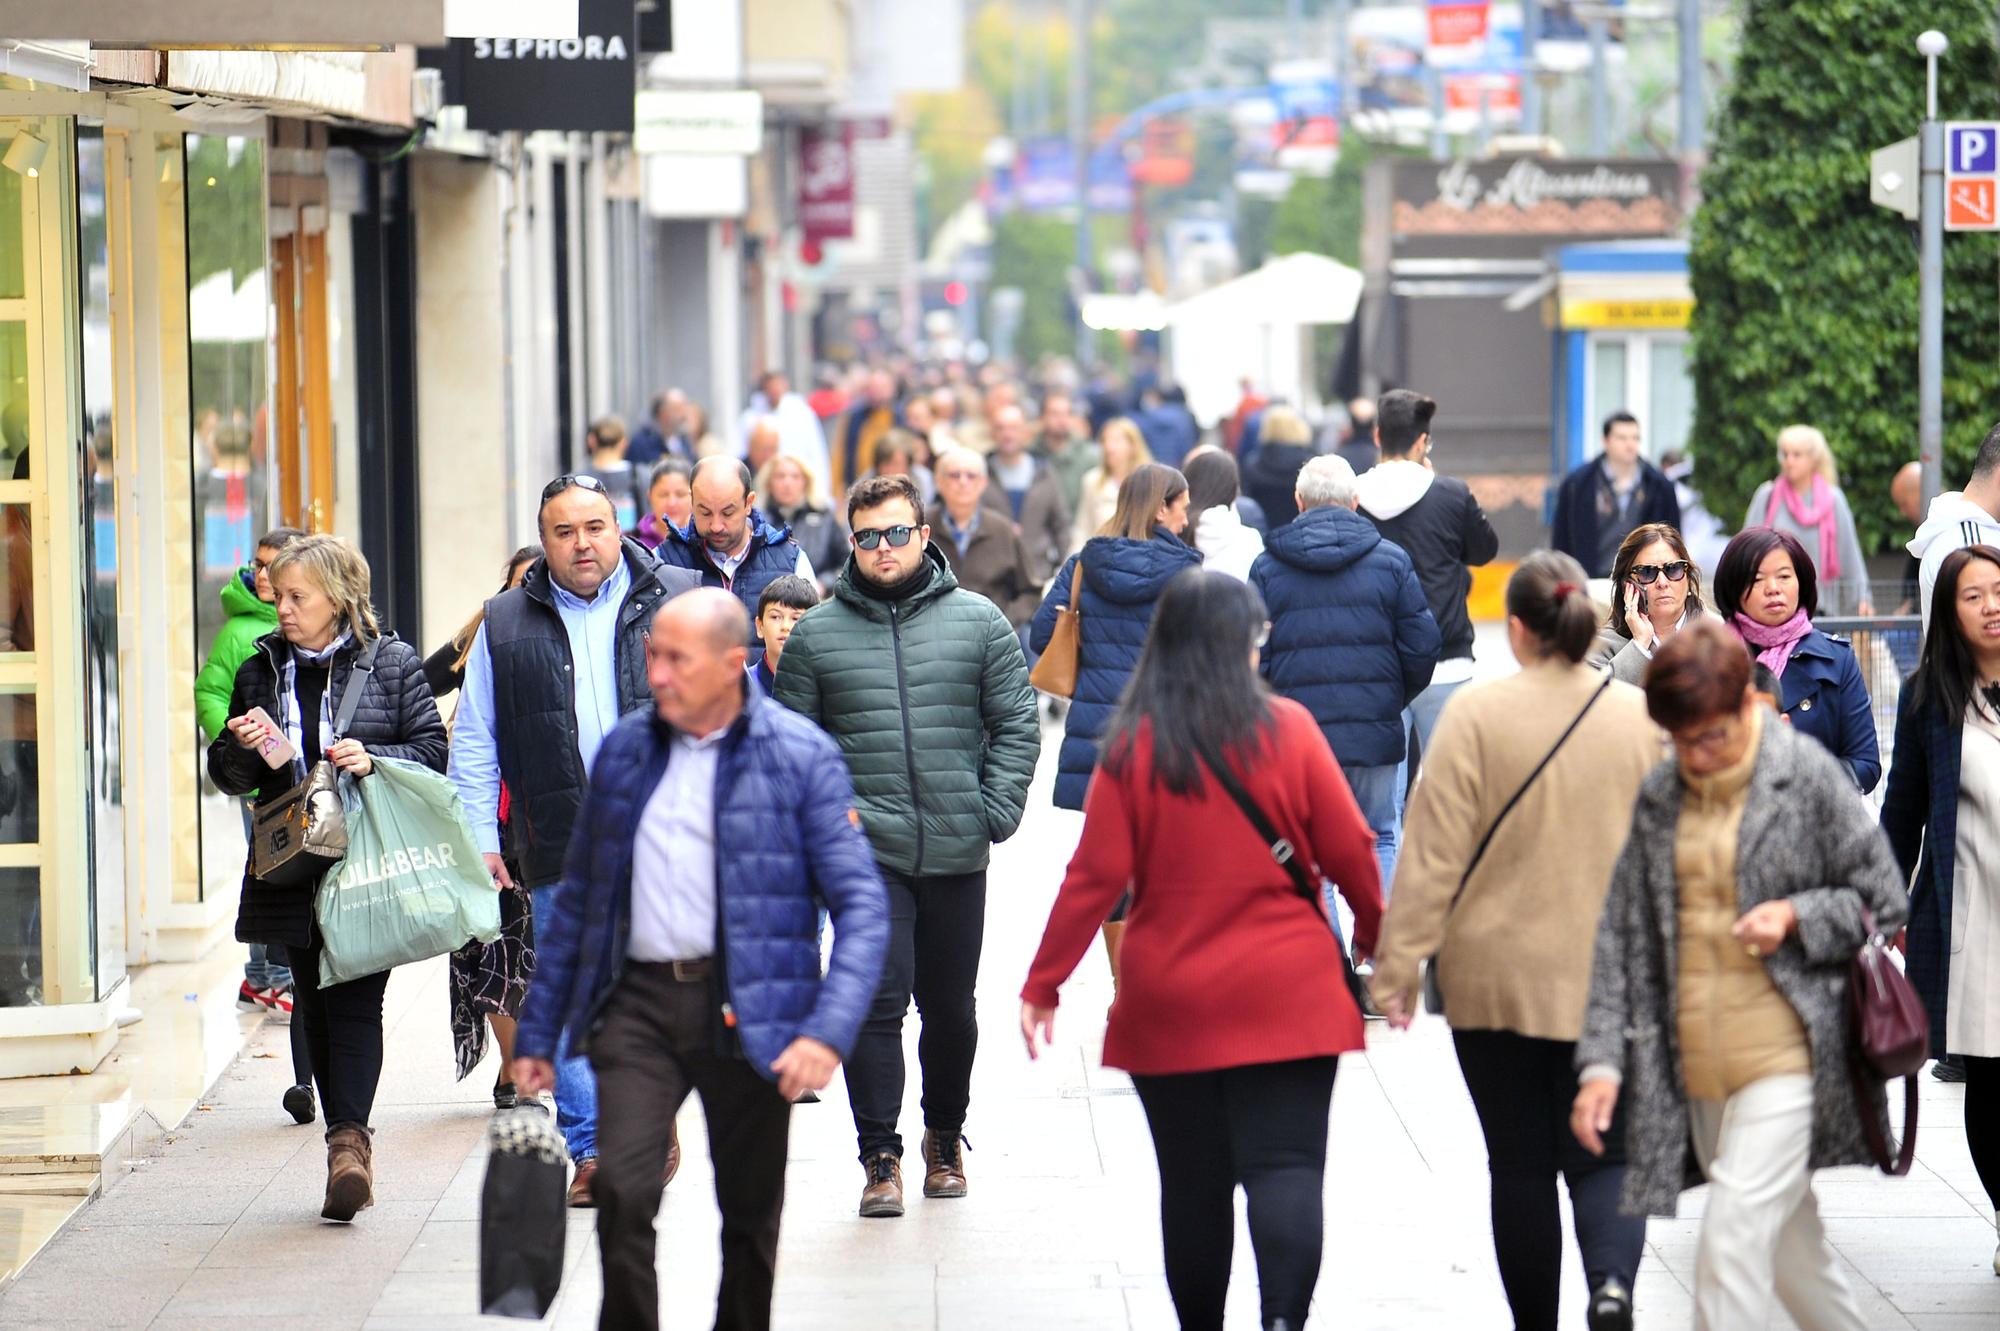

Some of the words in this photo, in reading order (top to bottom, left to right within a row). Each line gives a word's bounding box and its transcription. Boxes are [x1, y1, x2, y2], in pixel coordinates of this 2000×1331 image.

[474, 35, 628, 60] SEPHORA
[1960, 130, 1987, 171] P
[334, 842, 458, 892] ULL&BEAR
